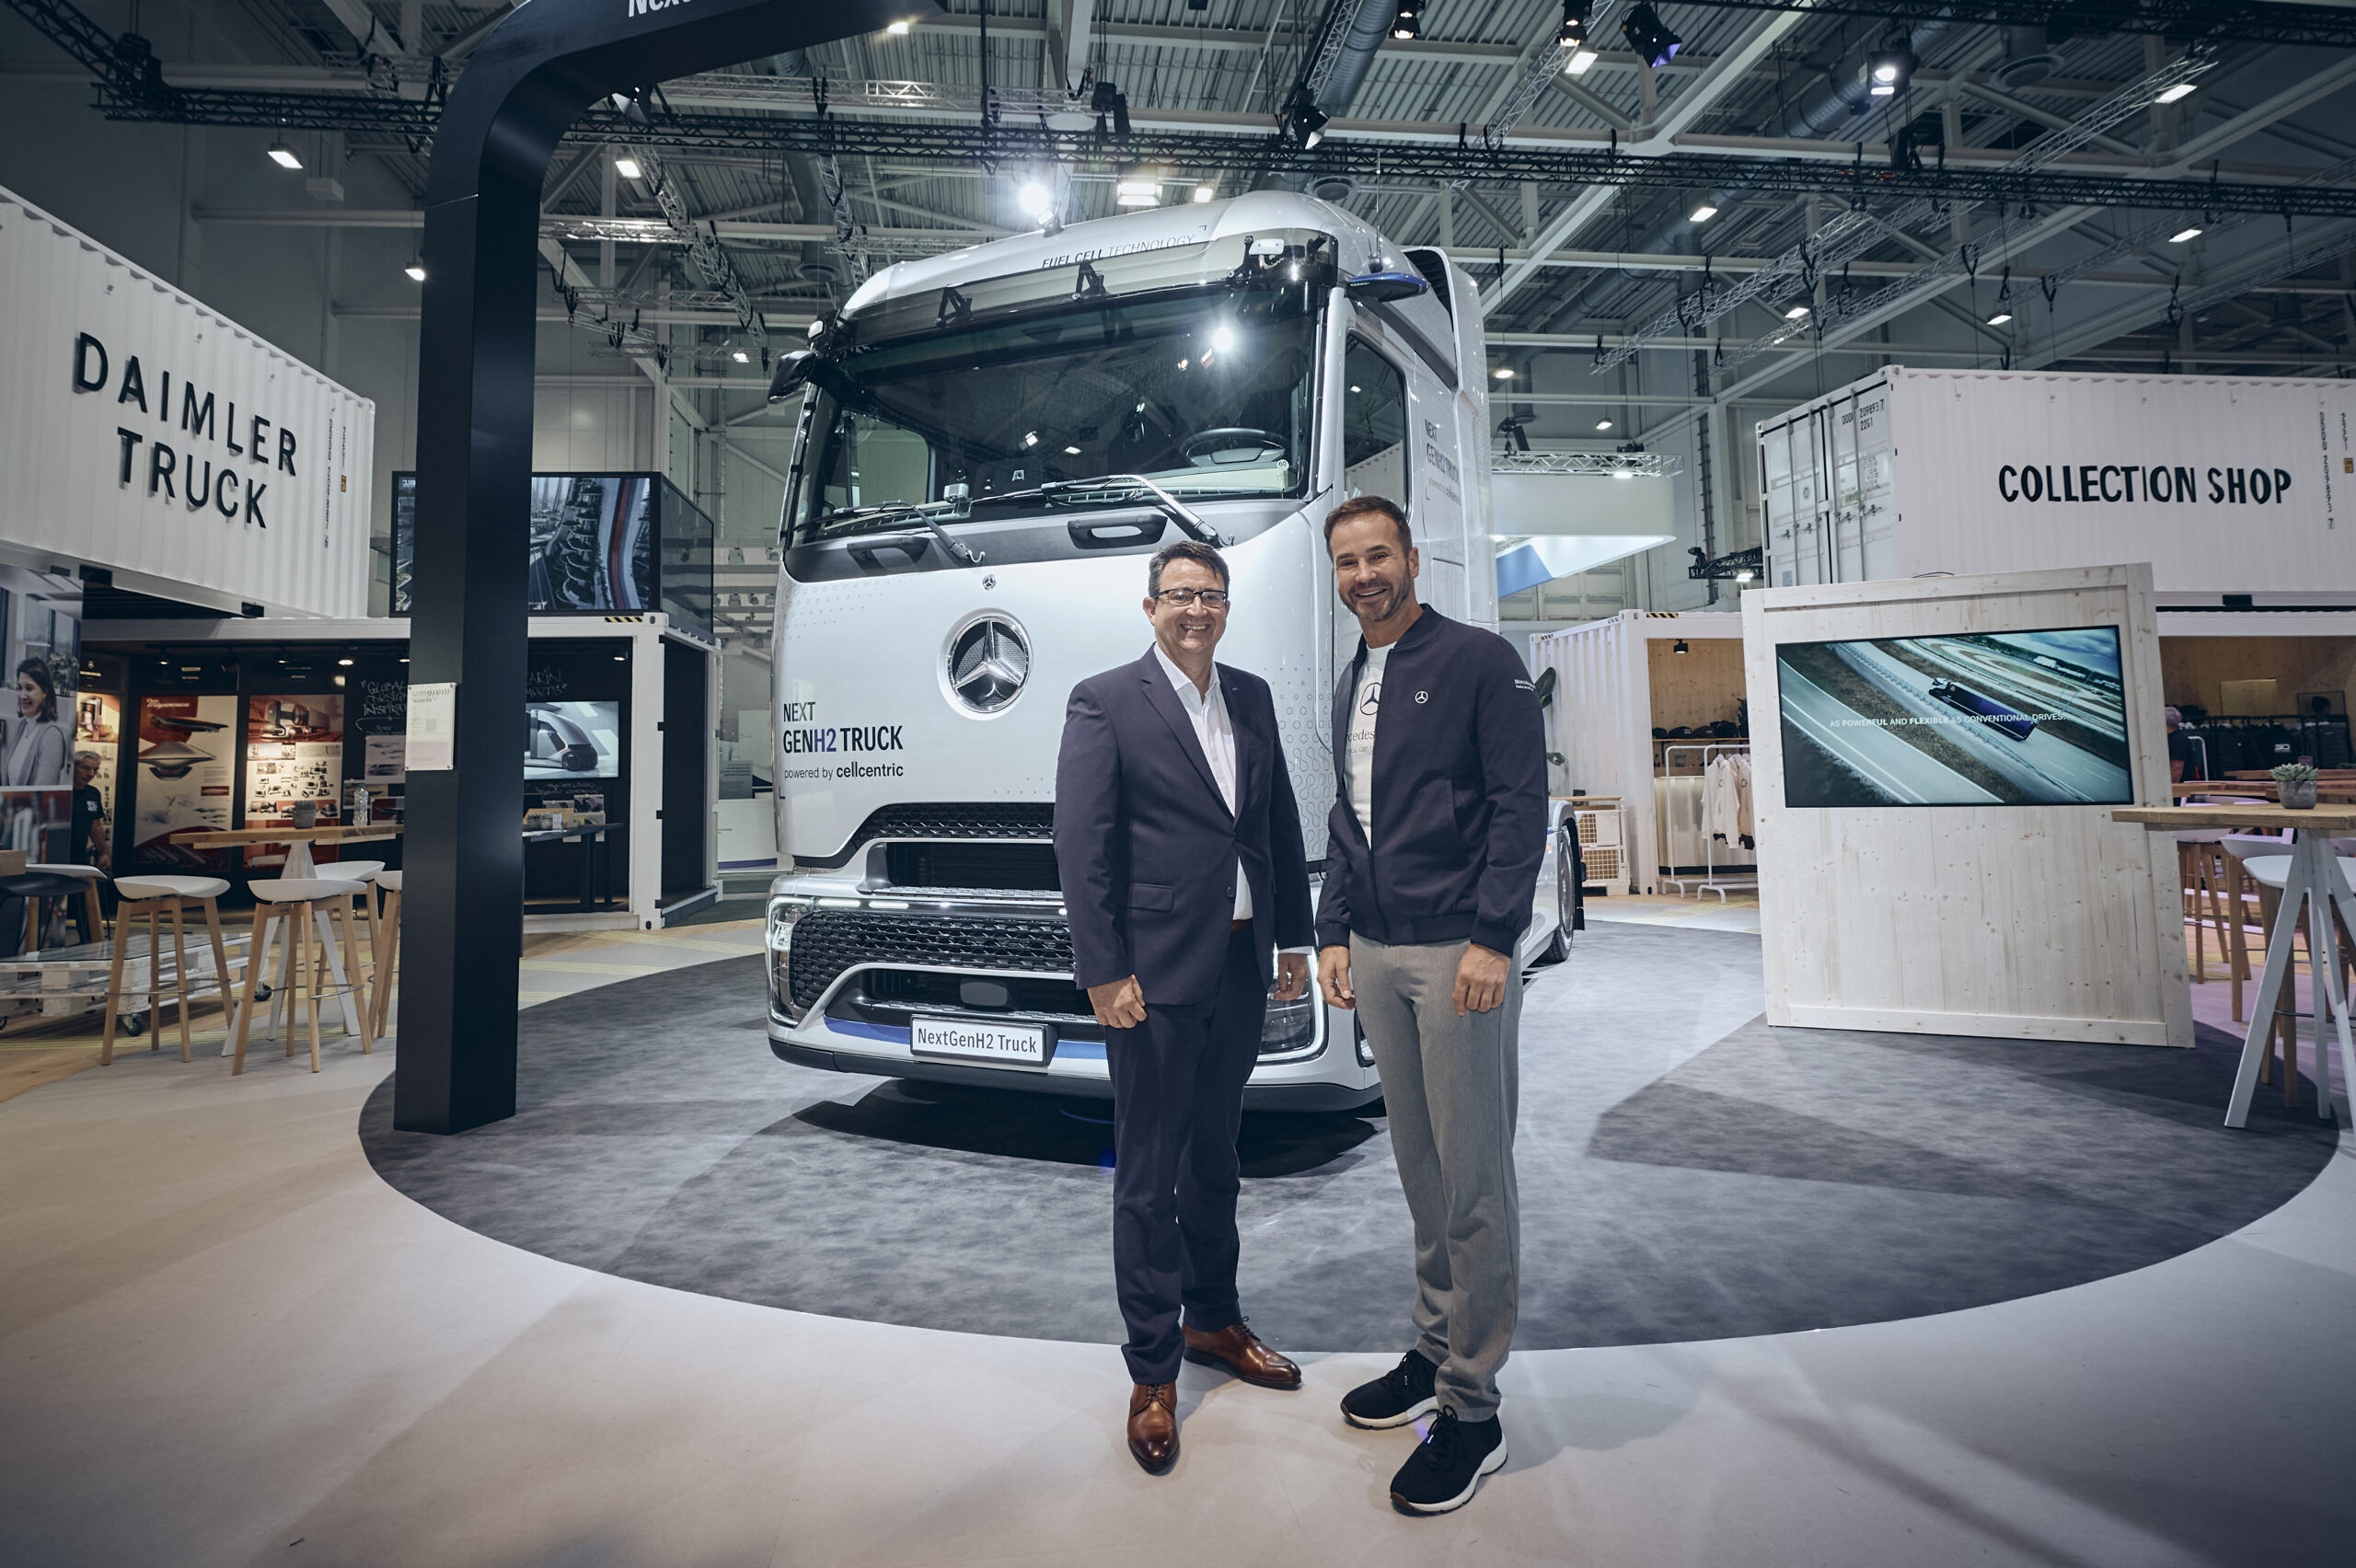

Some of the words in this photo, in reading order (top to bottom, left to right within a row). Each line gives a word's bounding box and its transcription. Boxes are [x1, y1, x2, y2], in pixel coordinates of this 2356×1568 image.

[1042, 254, 1071, 268] FUEL
[1075, 248, 1103, 262] CELL
[1107, 235, 1195, 256] TECHNOLOGY
[77, 331, 296, 477] DAIMLER
[1860, 402, 1879, 418] 209893
[117, 426, 268, 529] TRUCK
[1998, 465, 2198, 503] COLLECTION
[2207, 467, 2292, 505] SHOP
[783, 701, 815, 722] NEXT
[1830, 720, 1841, 728] AS
[1842, 718, 1888, 727] POWERFUL
[1889, 718, 1908, 726] AND
[1909, 716, 1949, 725] FLEXIBLE
[1964, 713, 2030, 723] CONVENTIONAL
[783, 728, 837, 754] GENH2
[839, 725, 904, 752] TRUCK
[784, 767, 819, 779] powered
[822, 767, 834, 780] by
[836, 761, 904, 778] cellcentric
[918, 1028, 994, 1049] NextGenH2
[998, 1034, 1037, 1053] Truck
